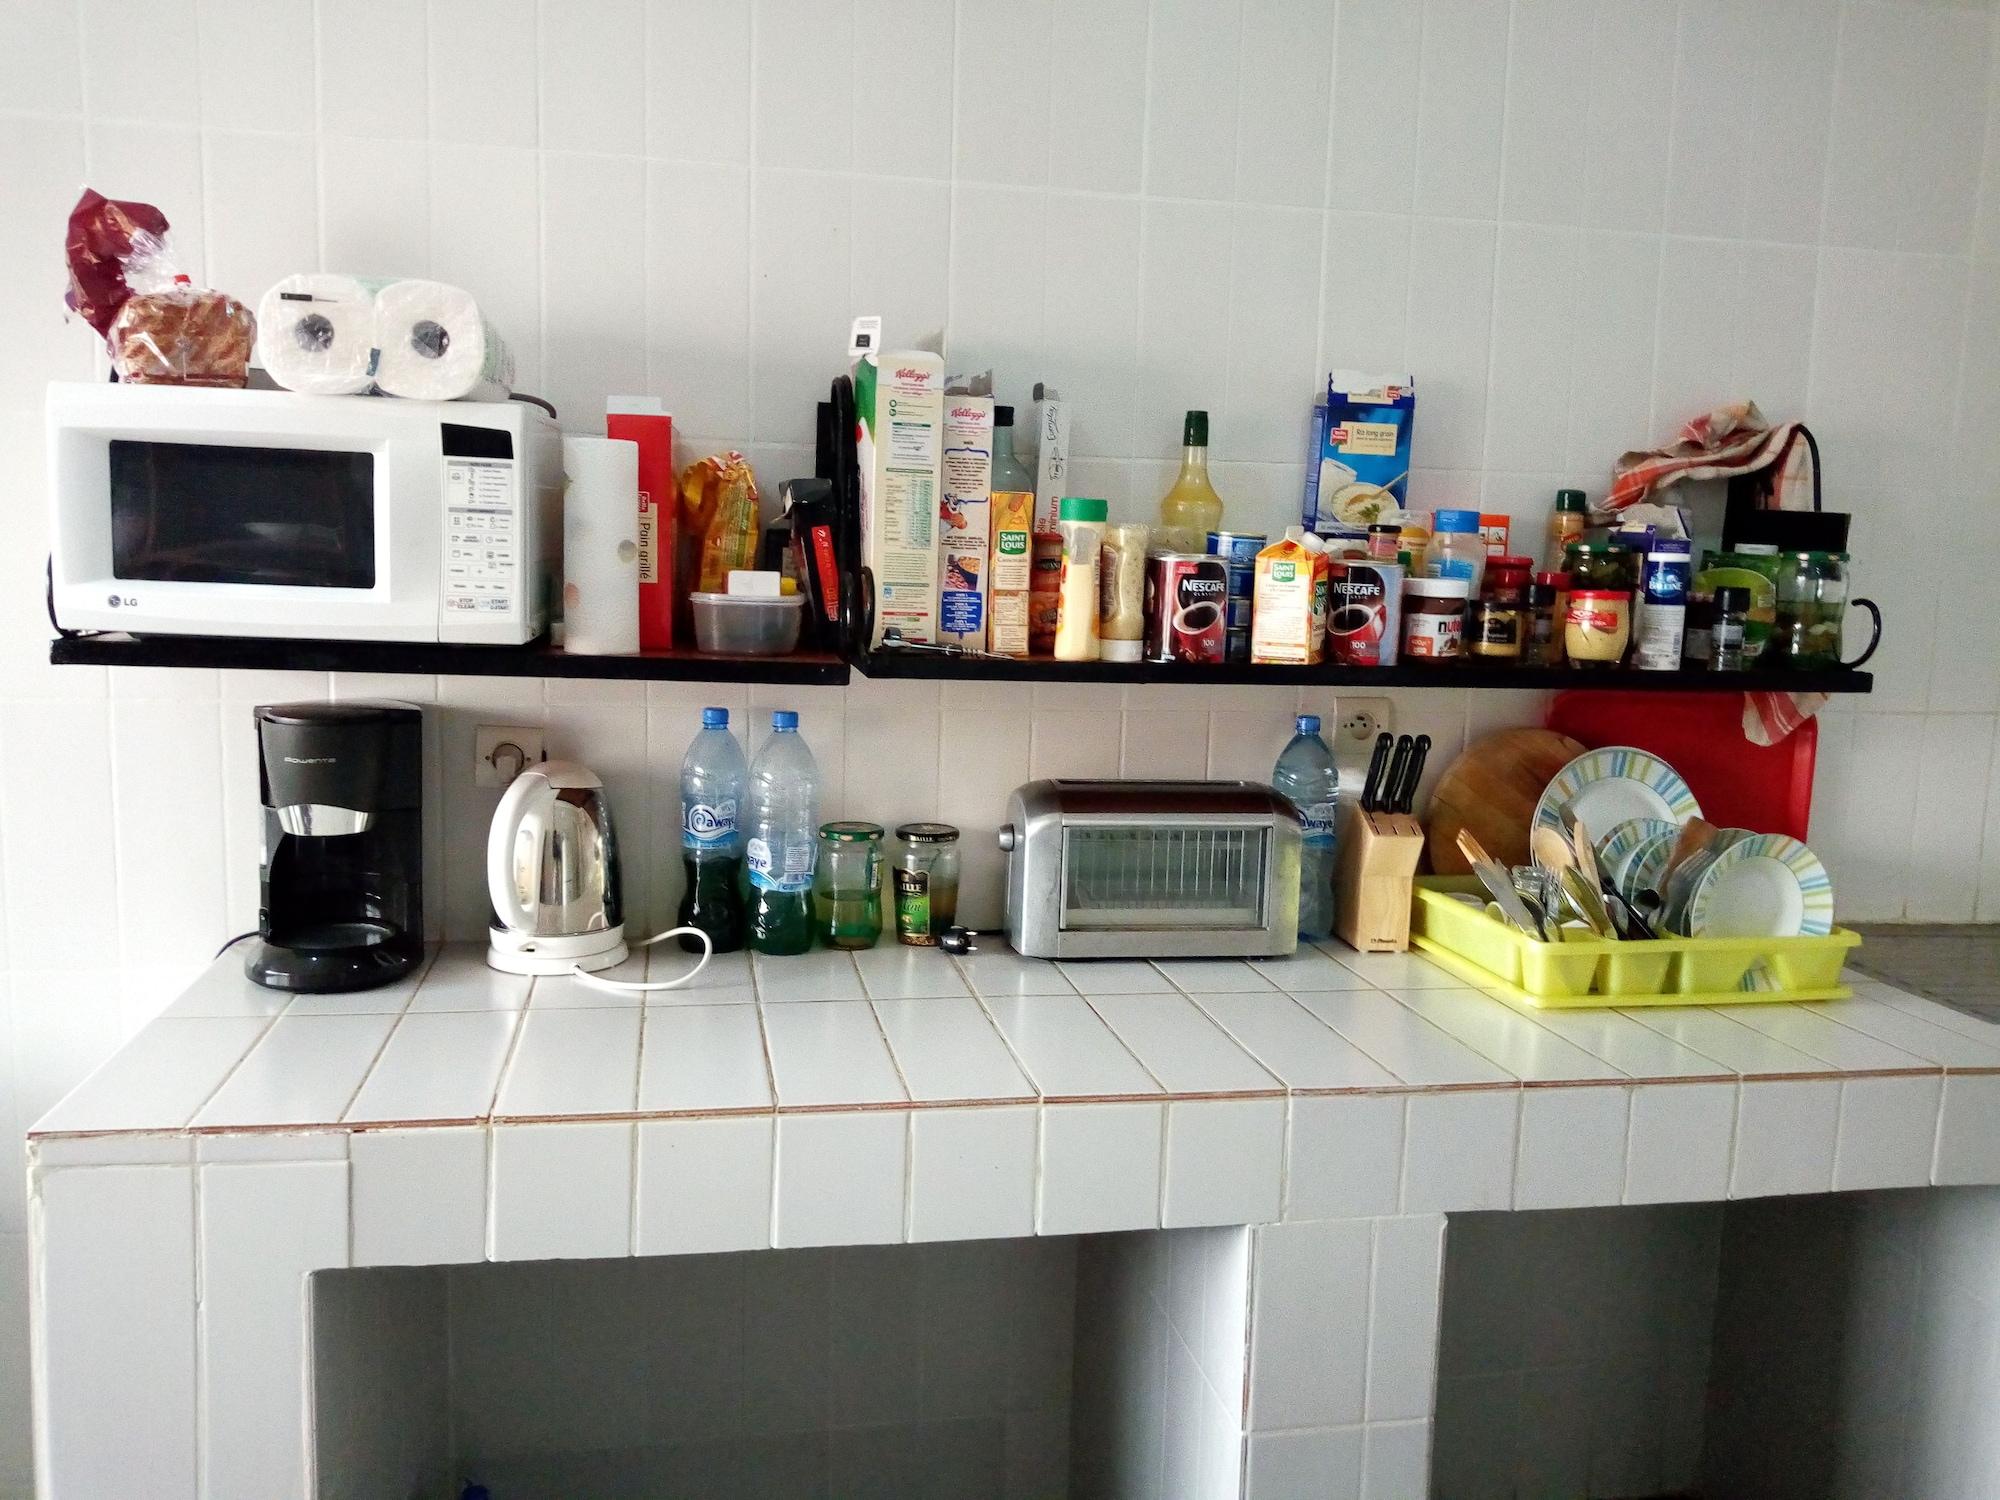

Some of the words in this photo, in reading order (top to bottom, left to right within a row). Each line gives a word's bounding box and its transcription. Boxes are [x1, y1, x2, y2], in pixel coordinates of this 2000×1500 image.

[640, 522, 651, 547] Pain
[1001, 533, 1026, 541] SAINT
[1001, 541, 1025, 550] LOUIS
[638, 551, 651, 579] grillé
[1273, 571, 1293, 579] LOUIS
[124, 598, 138, 606] LG
[1352, 641, 1366, 649] 100
